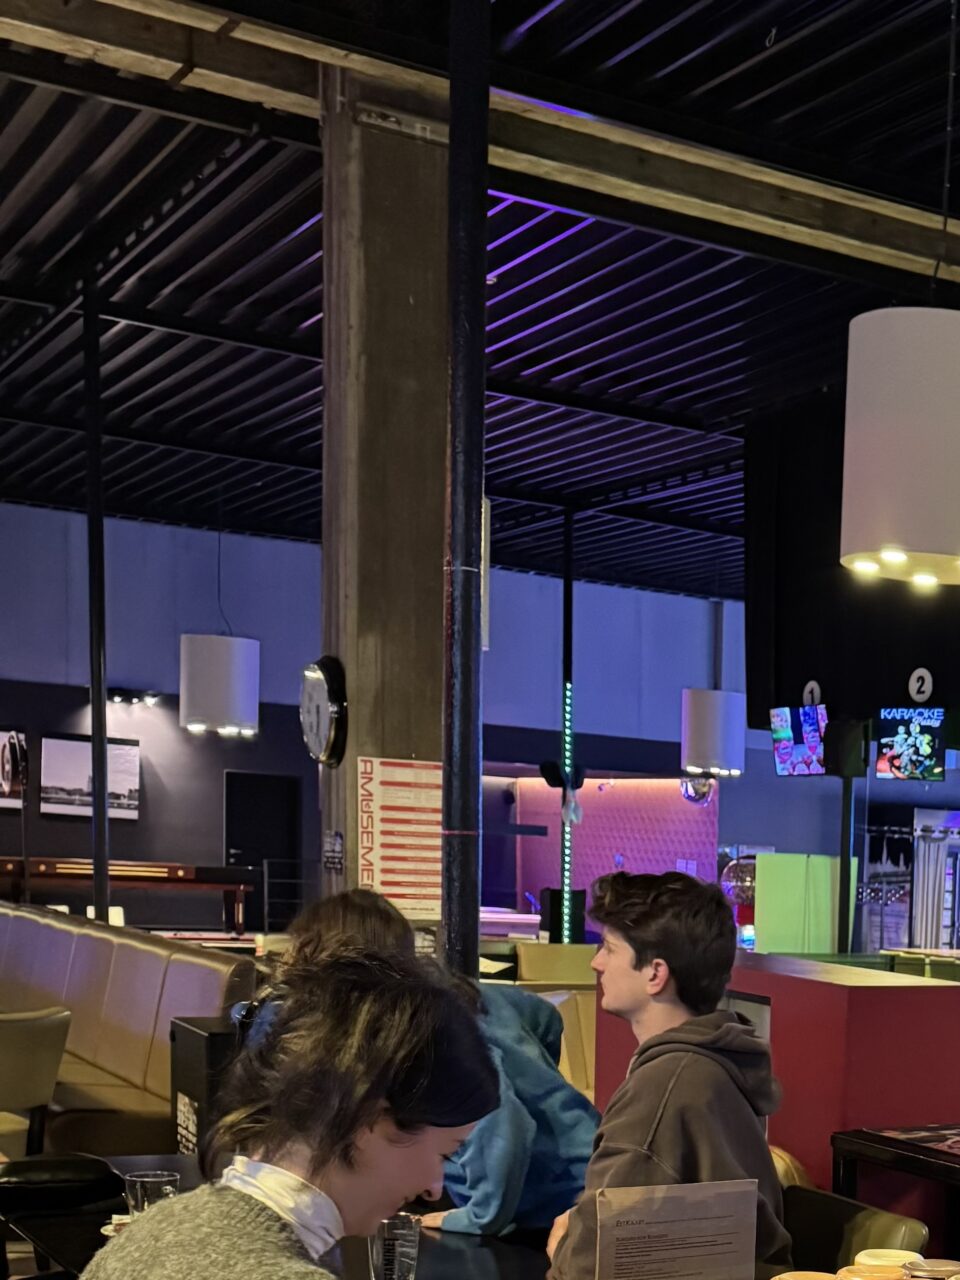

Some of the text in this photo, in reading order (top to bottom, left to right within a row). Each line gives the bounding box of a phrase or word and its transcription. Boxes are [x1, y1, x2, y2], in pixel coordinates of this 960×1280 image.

[916, 675, 925, 695] 2
[808, 687, 815, 704] 1
[880, 708, 944, 720] KARAOKE
